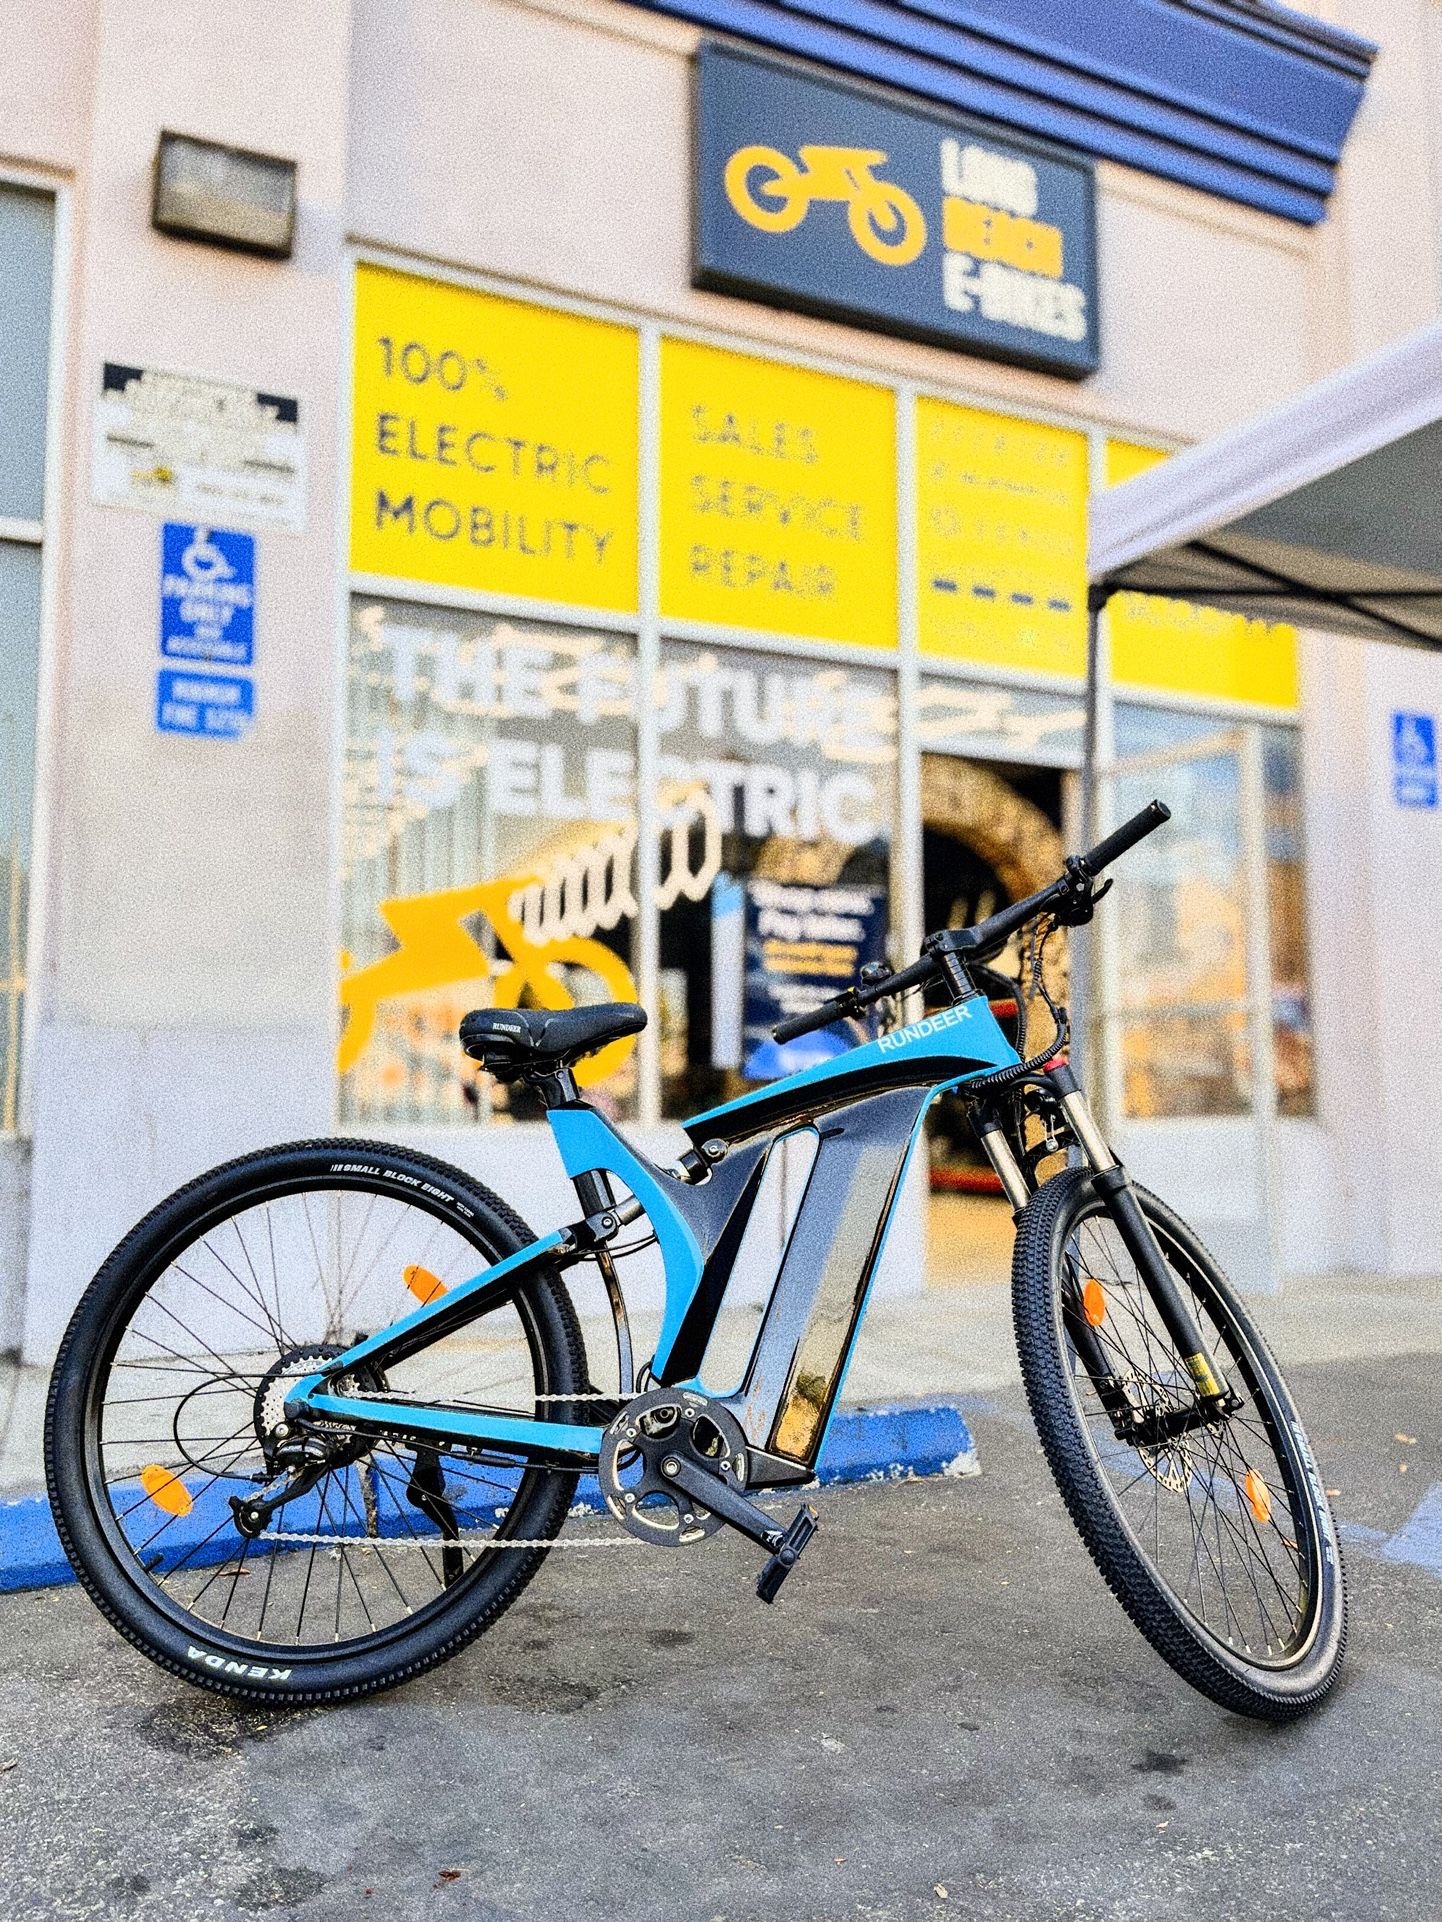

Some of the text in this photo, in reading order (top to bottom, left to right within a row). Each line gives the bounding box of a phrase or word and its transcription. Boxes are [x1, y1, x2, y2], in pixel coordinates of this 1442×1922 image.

[377, 335, 508, 402] 100%
[376, 411, 612, 495] ELECTRIC
[690, 404, 820, 465] SALES
[375, 489, 614, 565] MOBILITY
[690, 474, 865, 541] SERVICE
[690, 543, 836, 599] REPAIR
[380, 622, 889, 752] THE FUTURE
[376, 728, 878, 847] IS ELECTRIC
[877, 1003, 973, 1053] RUNDEER
[343, 1163, 454, 1202] SMALL BLOCK EIGHT
[187, 1645, 292, 1680] KENDA
